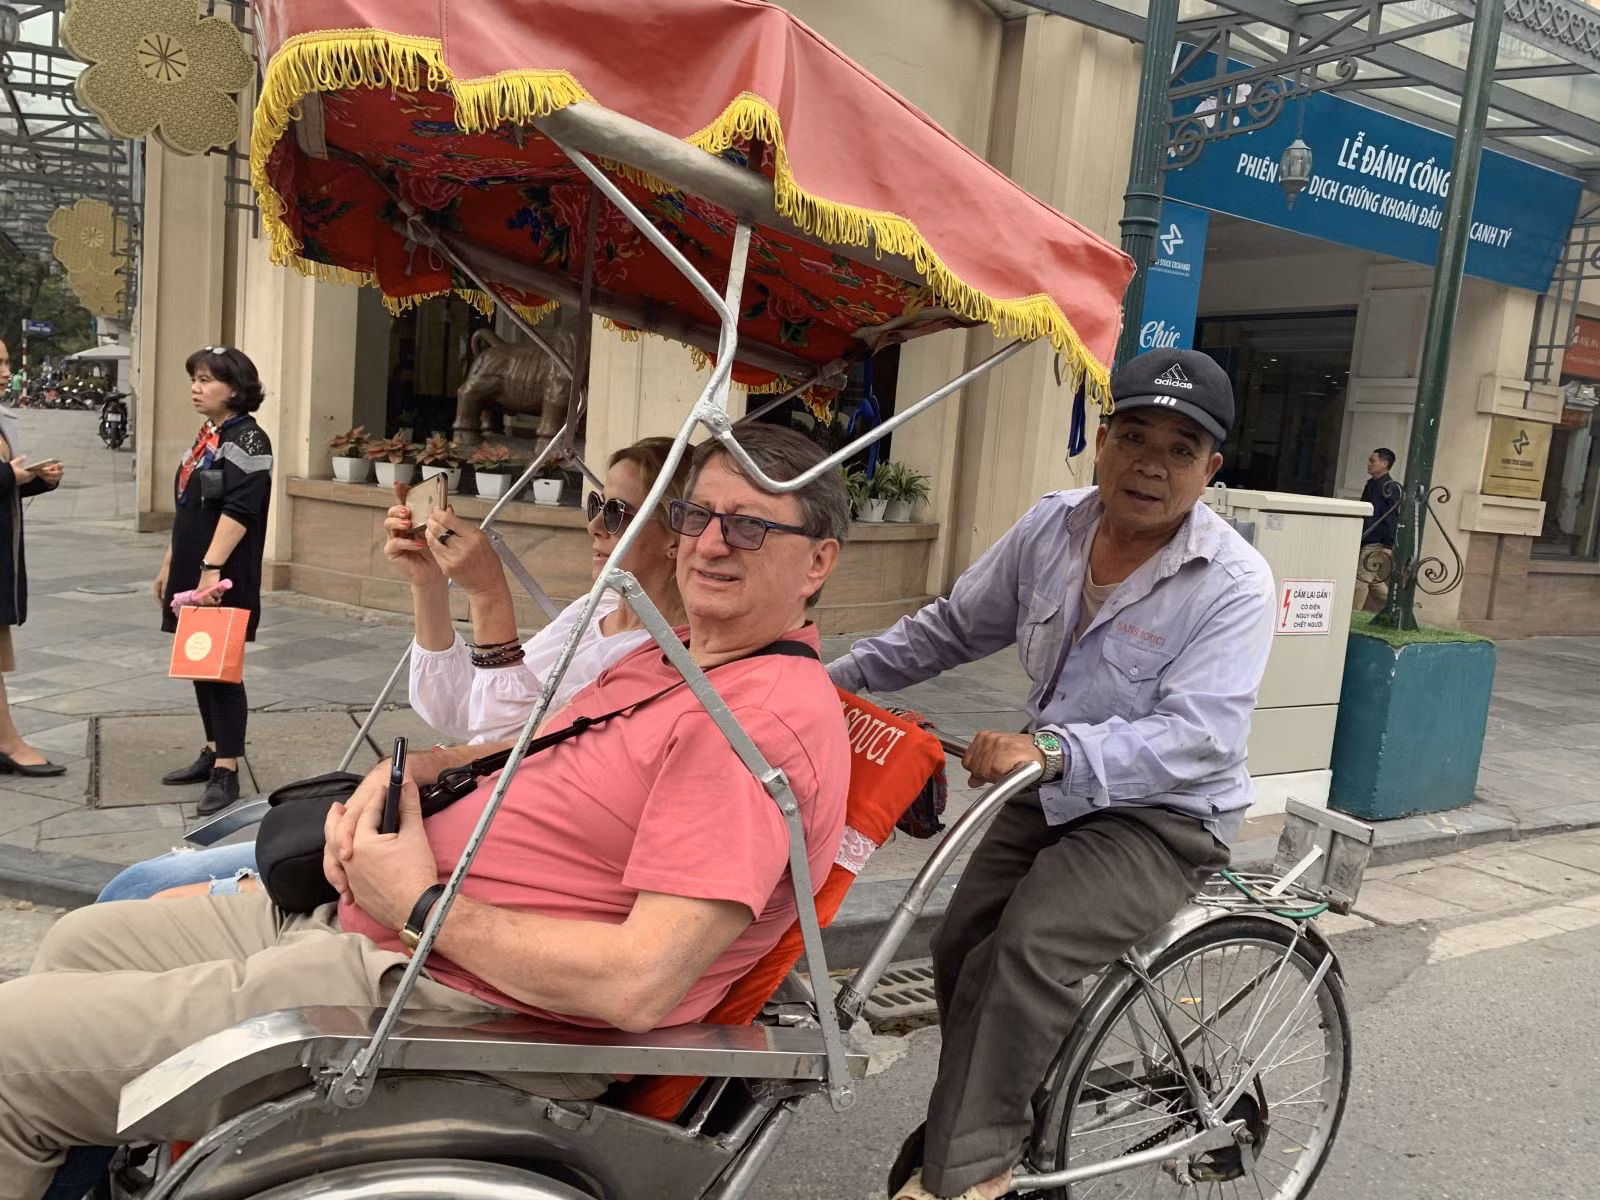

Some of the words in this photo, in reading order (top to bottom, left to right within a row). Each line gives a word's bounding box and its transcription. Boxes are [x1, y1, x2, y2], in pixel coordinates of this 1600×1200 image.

[1338, 131, 1365, 170] LỄ
[1360, 144, 1411, 185] ĐÁNH
[1409, 156, 1451, 198] CỒNG
[1236, 153, 1280, 183] PHIÊN
[1308, 175, 1340, 202] DỊCH
[1339, 185, 1381, 213] CHỨNG
[1379, 196, 1420, 224] KHOÁN
[1469, 222, 1499, 245] CANH
[1140, 320, 1181, 349] Chúc
[1154, 378, 1193, 390] adidas
